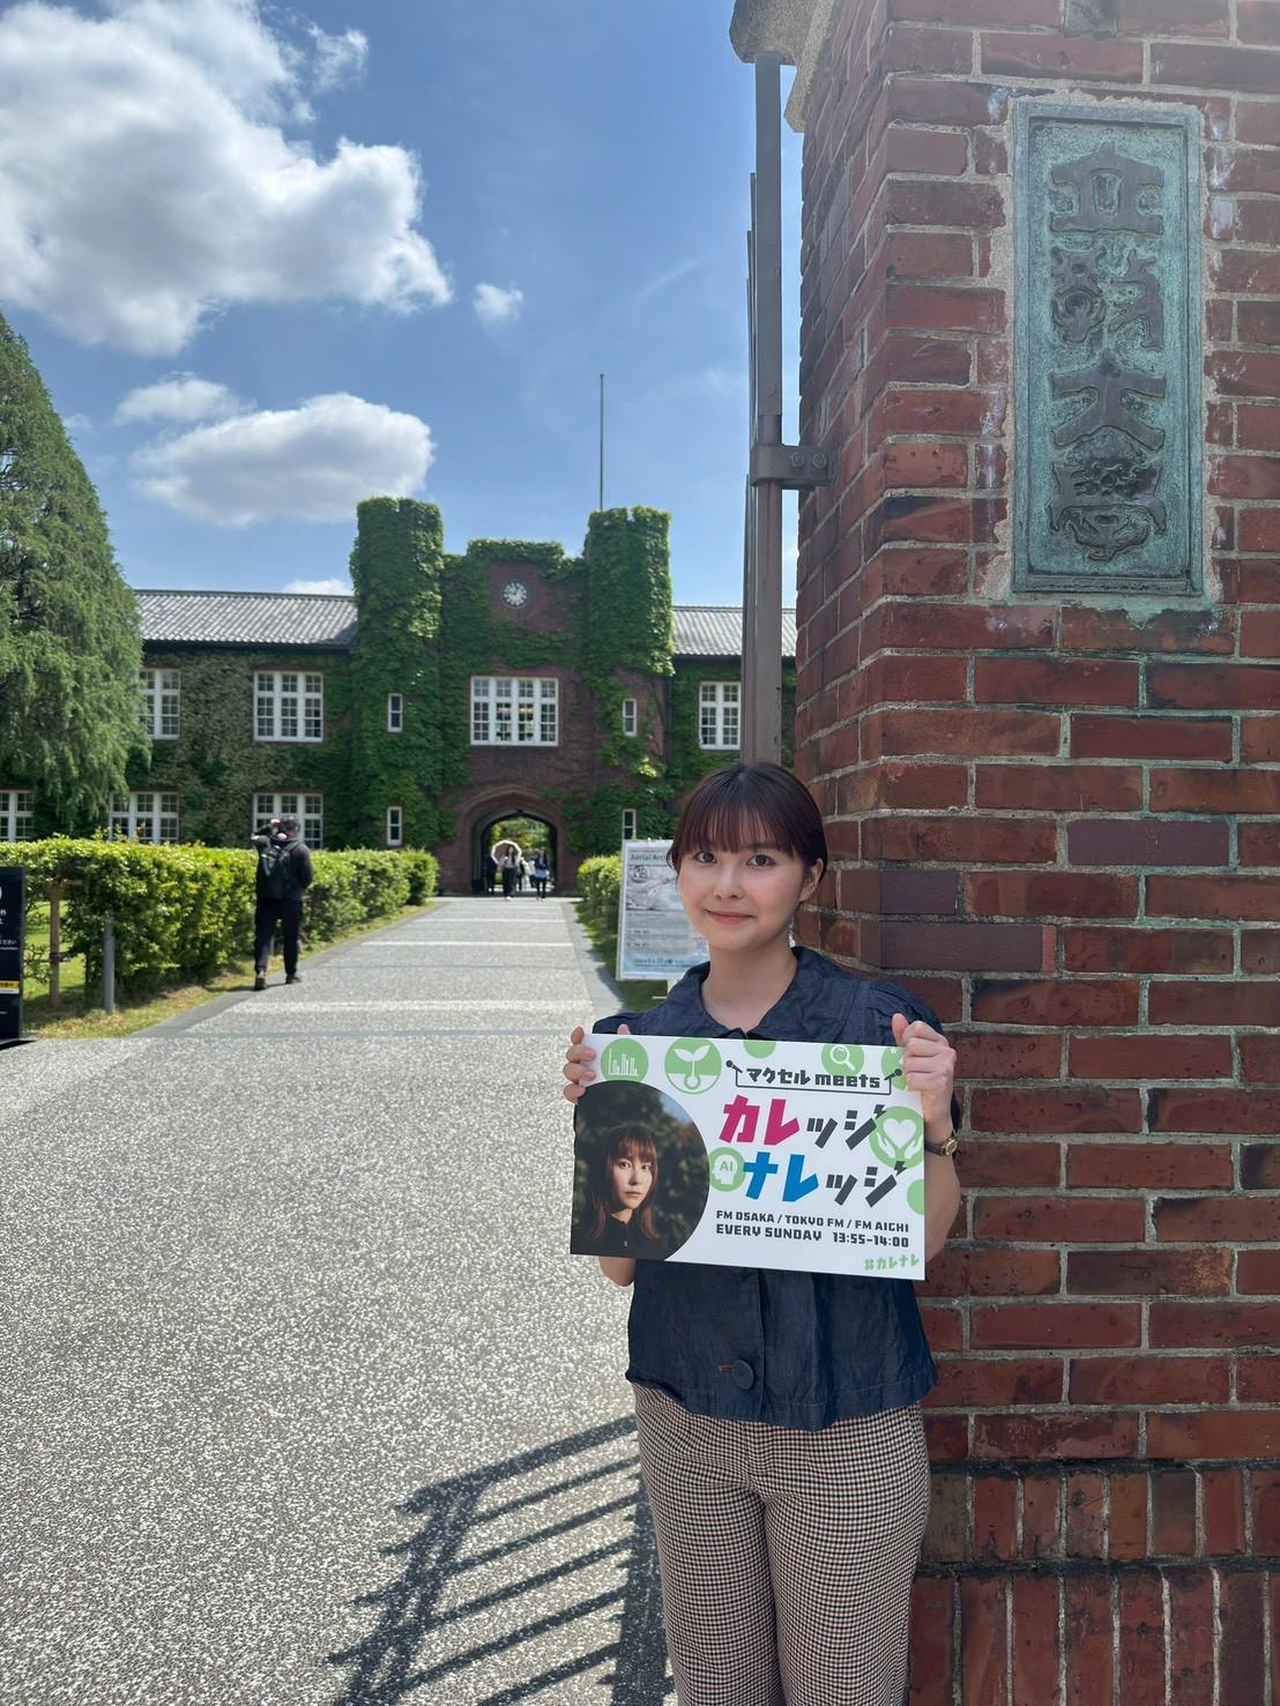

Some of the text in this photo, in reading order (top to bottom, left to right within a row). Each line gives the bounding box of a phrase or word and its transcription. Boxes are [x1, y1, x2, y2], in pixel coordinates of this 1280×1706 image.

[746, 1067, 880, 1088] マクセル meets
[719, 1094, 887, 1150] カレッジ
[719, 1160, 733, 1171] AI
[743, 1151, 908, 1208] ナレッジ
[716, 1210, 733, 1220] FM
[735, 1212, 774, 1223] OSAKA
[785, 1215, 824, 1226] TOKYO
[827, 1219, 844, 1228] FM
[855, 1220, 872, 1230] FM
[875, 1221, 909, 1233] AICHI
[716, 1223, 910, 1248] EVERY SUNDAY 13:55-14:00
[864, 1254, 920, 1271] #カレナレ
